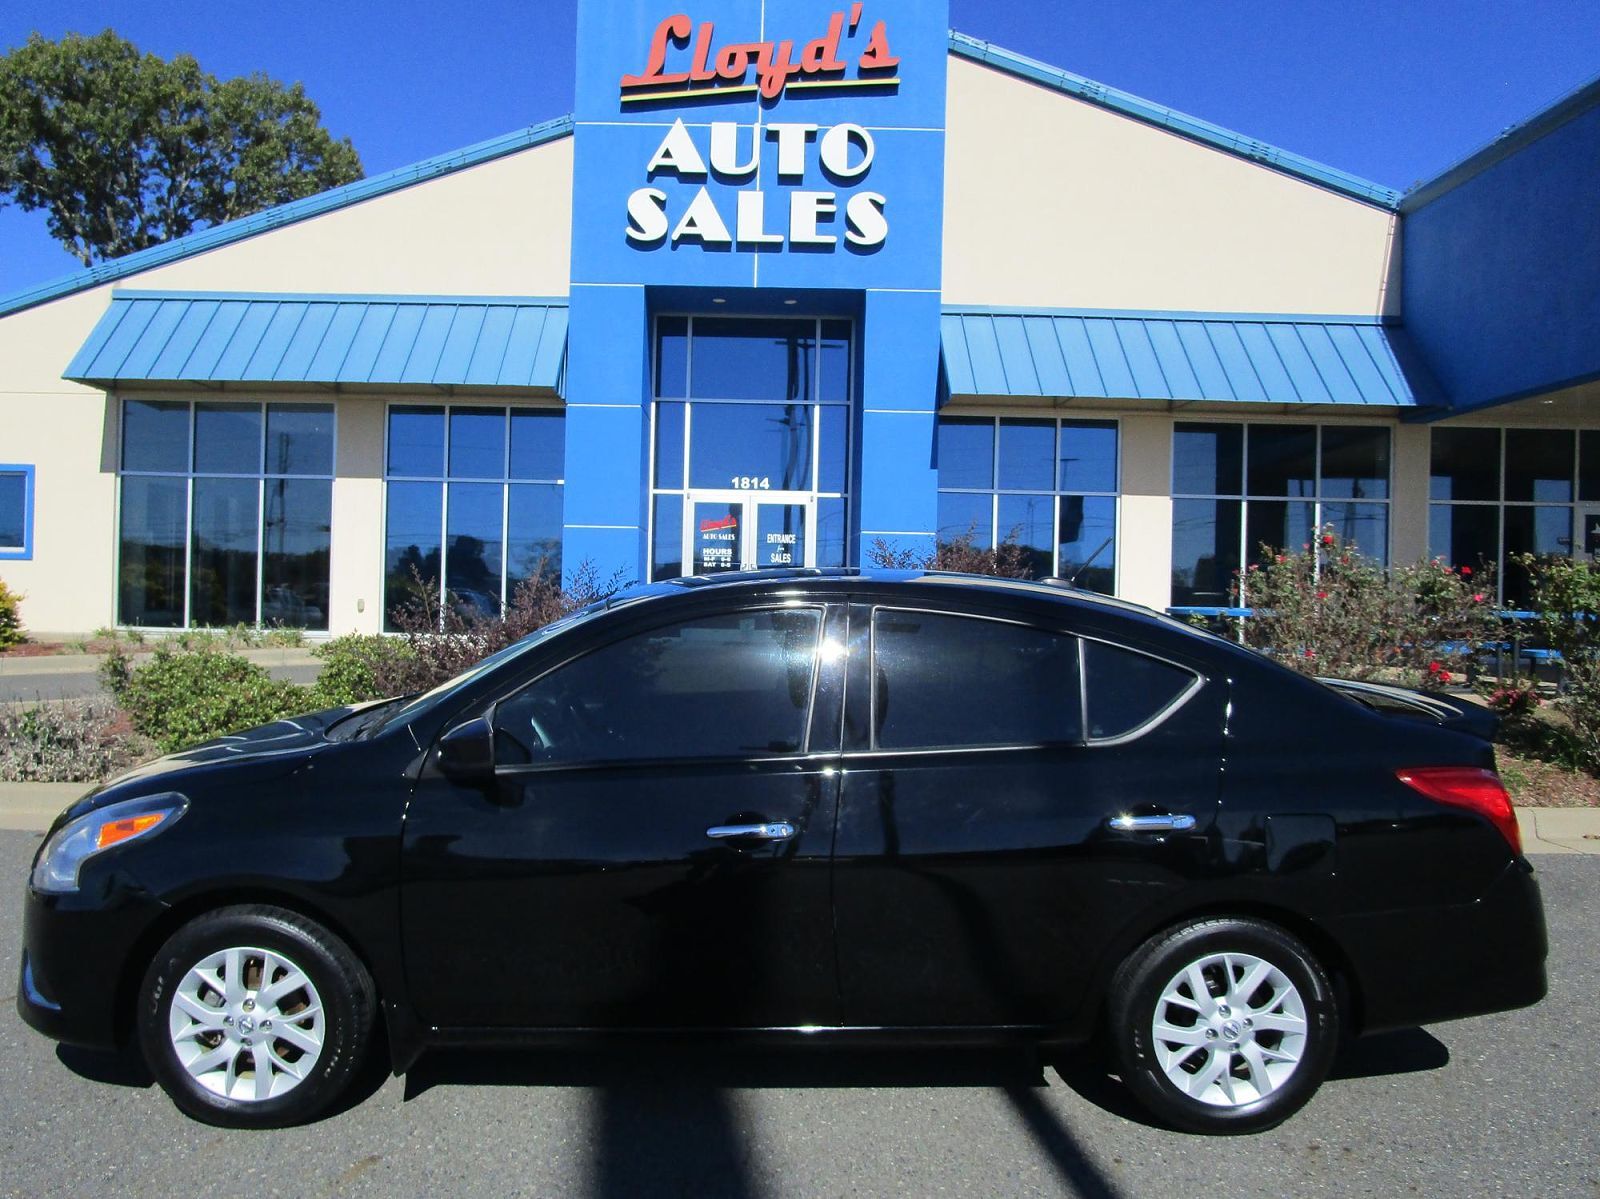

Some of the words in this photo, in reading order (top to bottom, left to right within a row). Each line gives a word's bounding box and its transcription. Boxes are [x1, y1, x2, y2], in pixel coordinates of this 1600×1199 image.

[620, 2, 900, 99] Lloyd's
[646, 117, 875, 178] AUTO
[625, 185, 889, 246] SALES
[731, 476, 770, 490] 1814
[766, 533, 796, 544] ENTRANCE
[703, 547, 732, 555] HOURS
[770, 553, 791, 563] SALES
